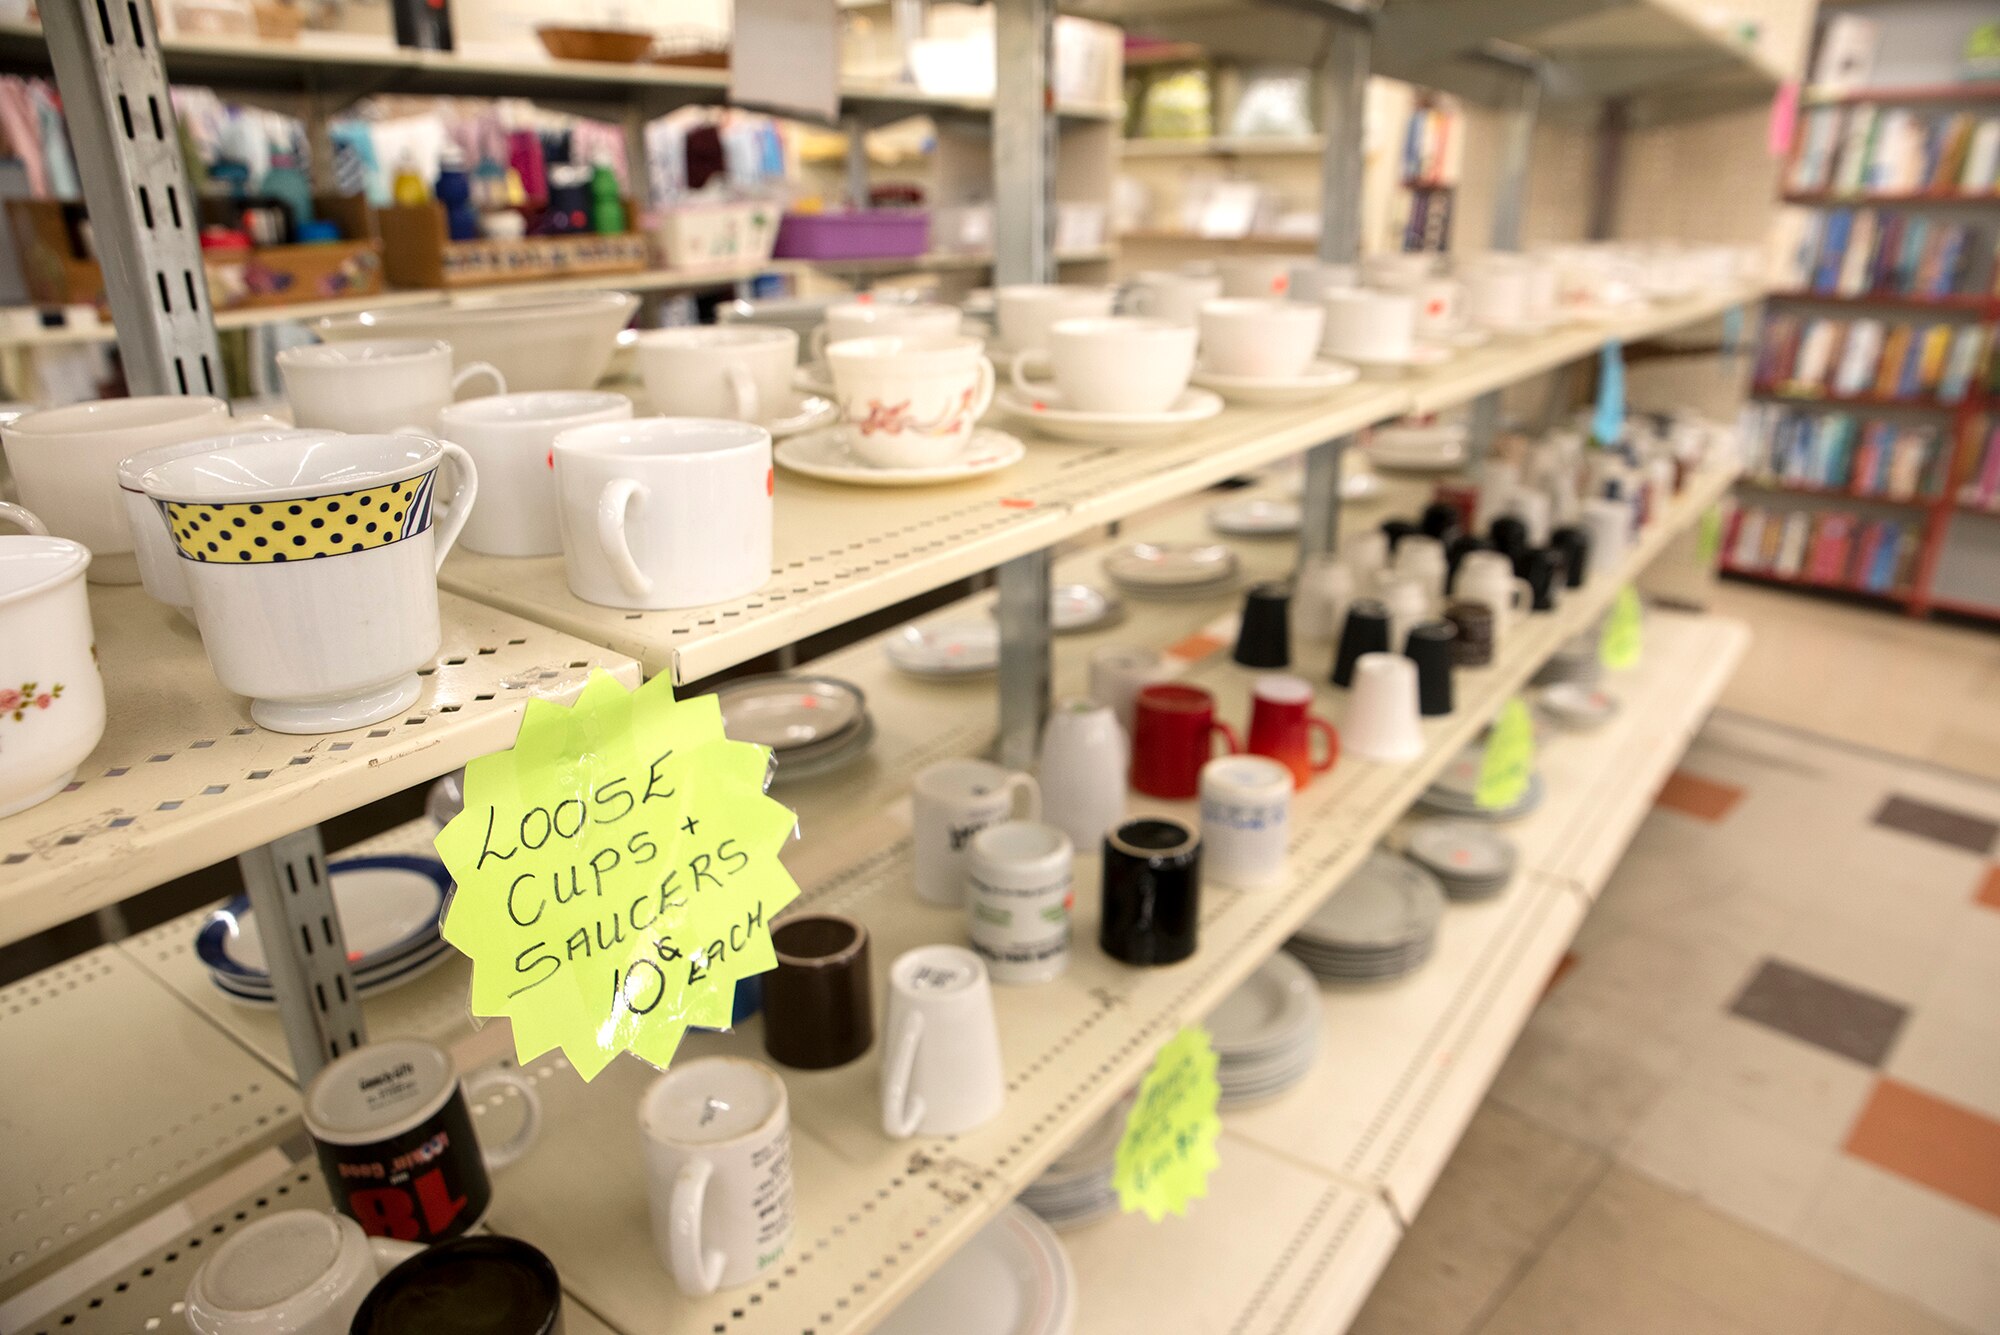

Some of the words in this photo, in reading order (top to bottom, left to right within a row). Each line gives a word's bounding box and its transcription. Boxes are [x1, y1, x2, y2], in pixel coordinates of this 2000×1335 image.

[476, 750, 676, 870] LOOSE
[507, 831, 658, 926] CUPS
[507, 839, 749, 998] SAUCERS
[688, 900, 763, 985] EACH
